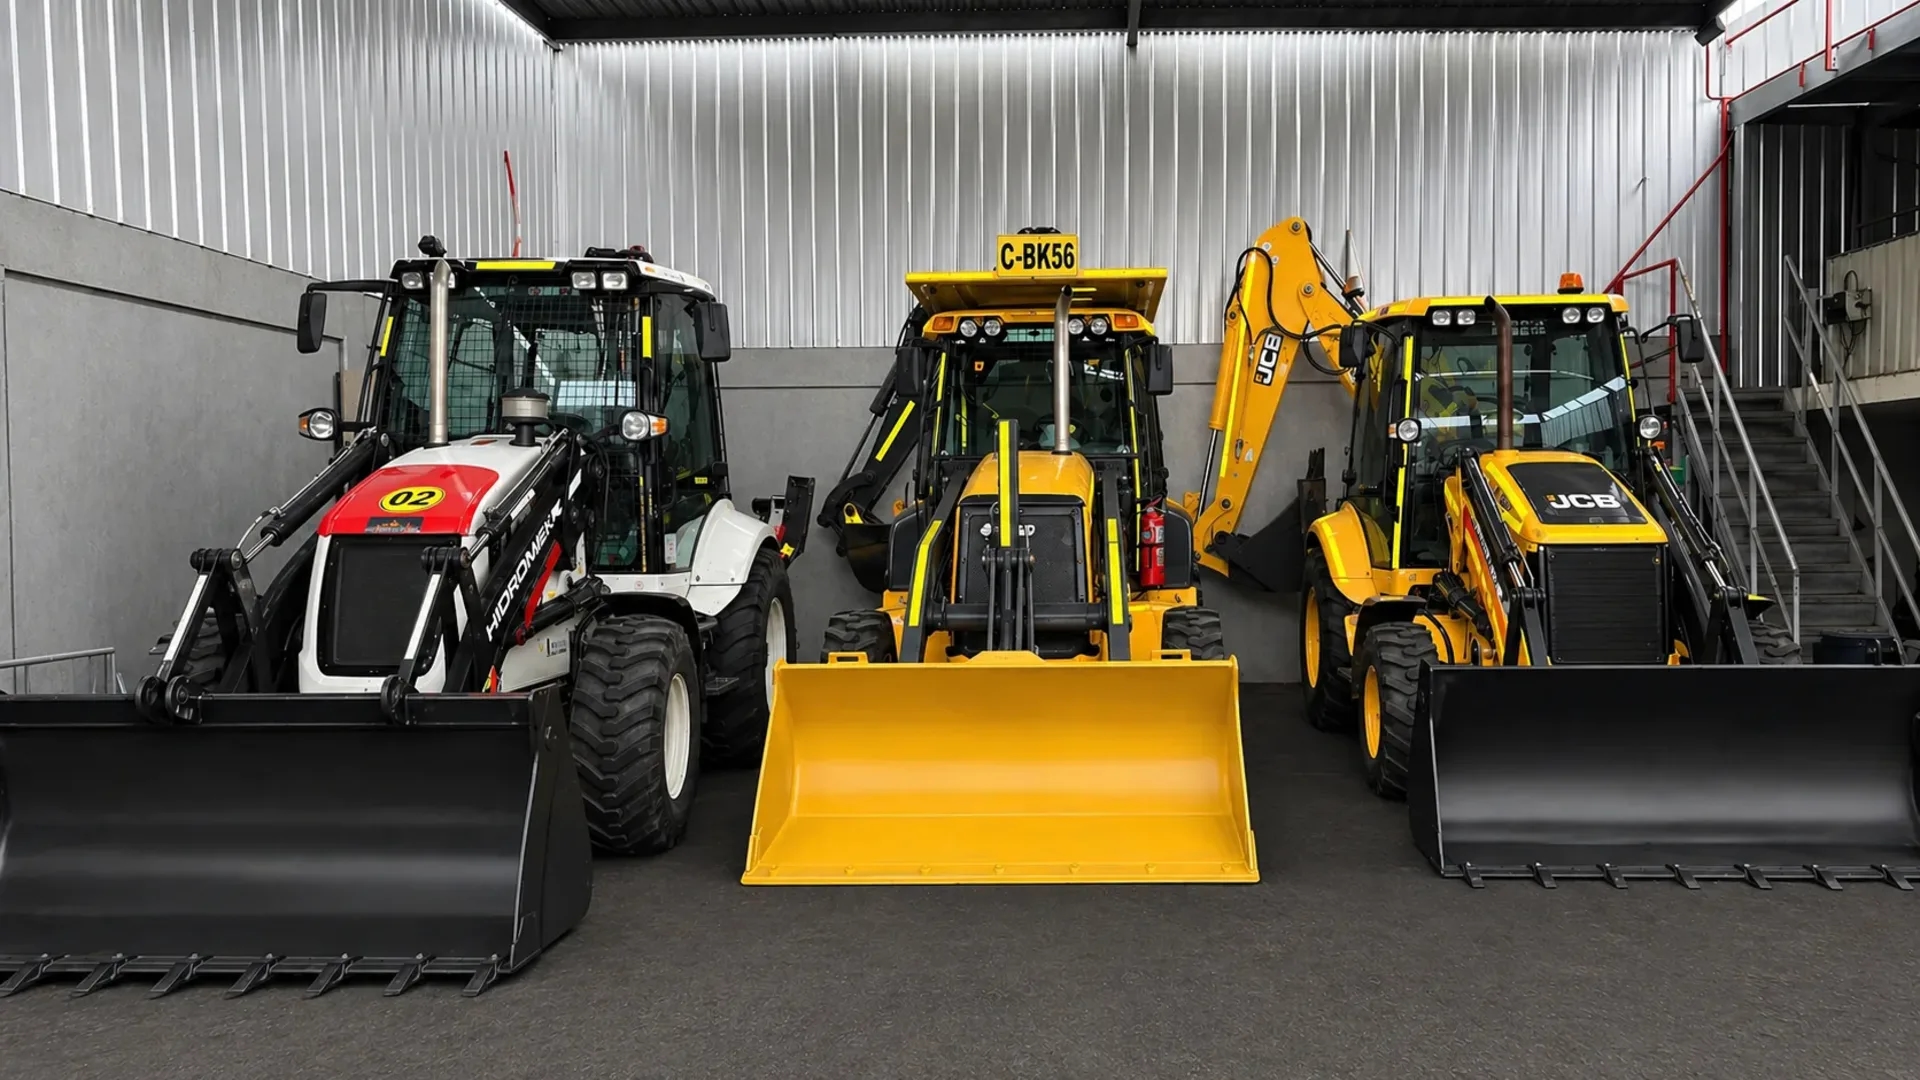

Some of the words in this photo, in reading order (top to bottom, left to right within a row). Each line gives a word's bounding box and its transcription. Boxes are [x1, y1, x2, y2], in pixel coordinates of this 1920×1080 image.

[1000, 242, 1075, 270] C-BK56
[1257, 333, 1282, 385] JCB
[389, 491, 436, 506] 02
[1549, 493, 1621, 509] JCB
[486, 513, 555, 642] HIDROMEK
